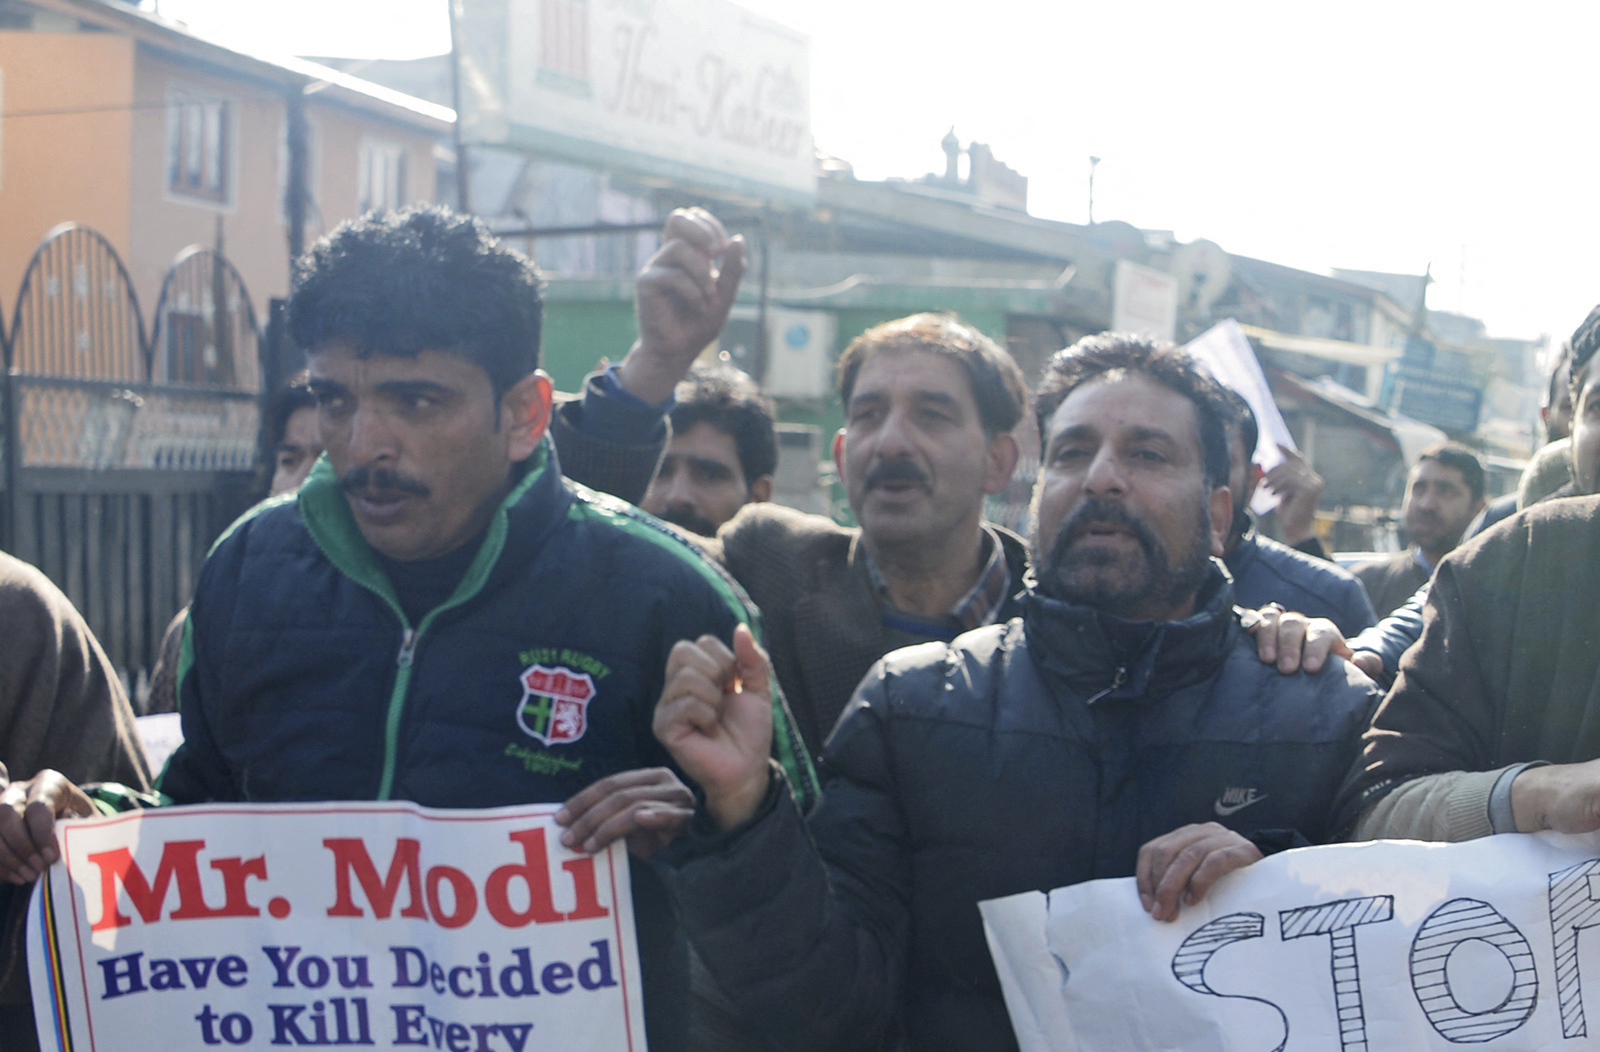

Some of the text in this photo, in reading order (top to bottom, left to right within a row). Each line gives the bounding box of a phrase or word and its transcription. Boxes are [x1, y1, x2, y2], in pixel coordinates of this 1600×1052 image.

[1223, 787, 1257, 804] NIKE
[88, 827, 610, 933] Mr. Modi
[98, 939, 618, 999] Have You Decided
[195, 1005, 253, 1045] to
[268, 998, 374, 1045] Kill
